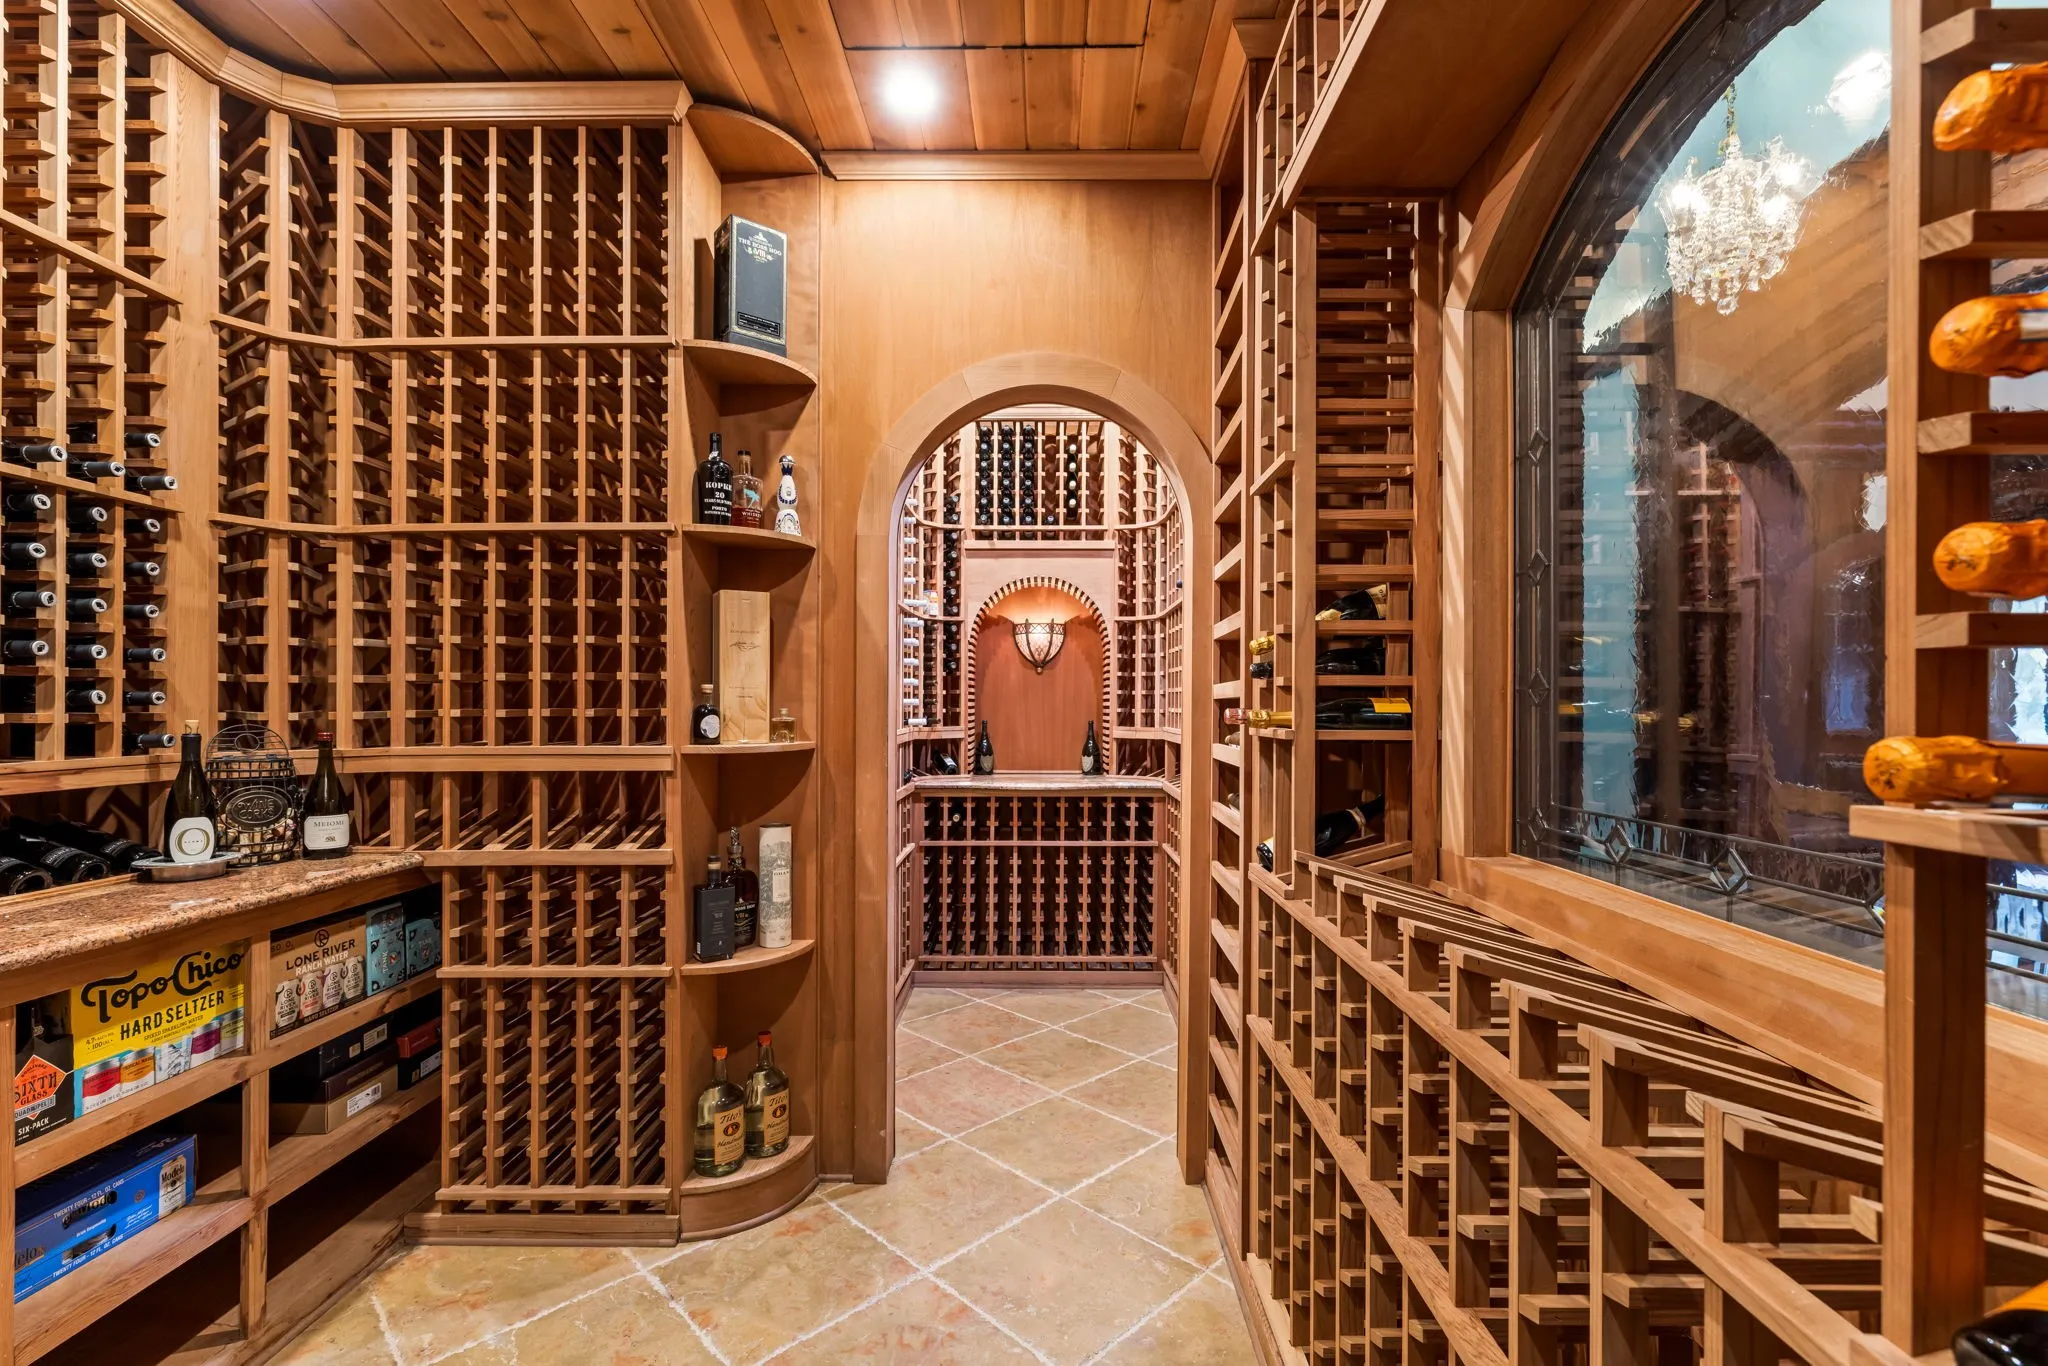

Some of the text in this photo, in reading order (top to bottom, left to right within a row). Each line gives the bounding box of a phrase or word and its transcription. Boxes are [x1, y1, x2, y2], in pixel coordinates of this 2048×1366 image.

[705, 481, 732, 491] KOPKE
[715, 491, 725, 499] 20
[313, 820, 344, 828] MEIOMI
[286, 939, 356, 971] LONE RIVER
[295, 951, 349, 977] RANCH WATER
[80, 950, 245, 1023] Topo Chico
[120, 990, 225, 1041] HARD SELTZER
[15, 1072, 57, 1104] SIXTH
[20, 1090, 48, 1106] GLASS
[18, 1117, 49, 1136] SIX-PACK
[53, 1203, 75, 1219] TWENTY
[74, 1196, 88, 1209] FOUR
[112, 1178, 125, 1189] CANS
[52, 1263, 73, 1278] TWENTY
[72, 1255, 87, 1266] FOUR
[111, 1233, 124, 1245] CANS
